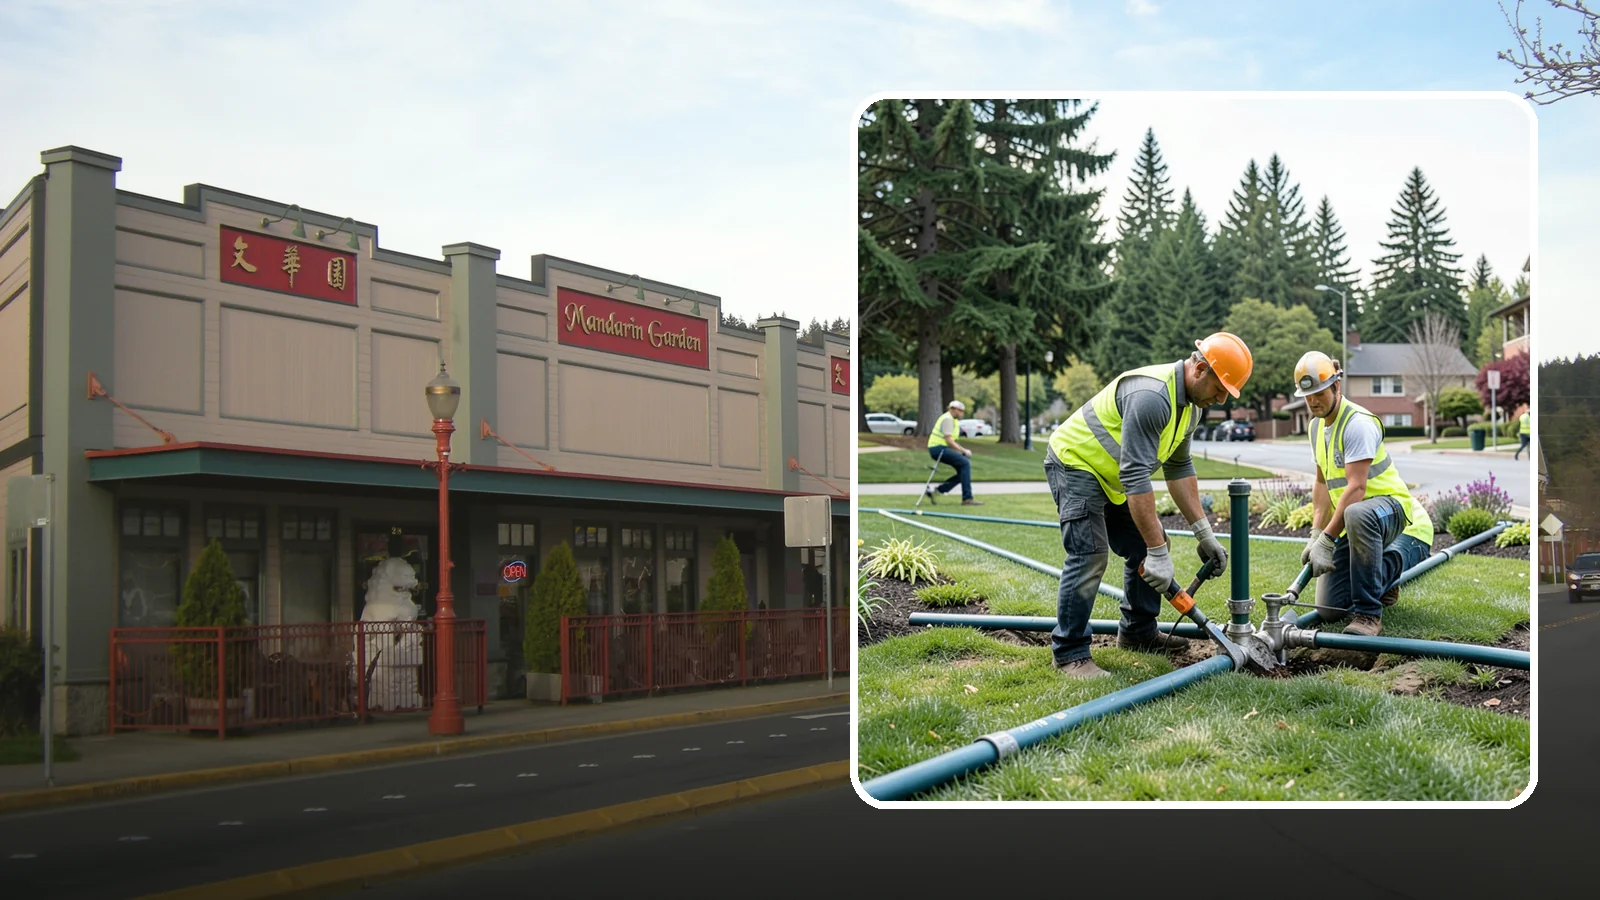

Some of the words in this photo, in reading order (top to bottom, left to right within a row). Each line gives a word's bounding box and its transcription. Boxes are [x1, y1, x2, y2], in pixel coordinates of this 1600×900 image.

[564, 302, 645, 341] Mandarin
[648, 320, 701, 352] Garden
[503, 565, 527, 578] OPEN
